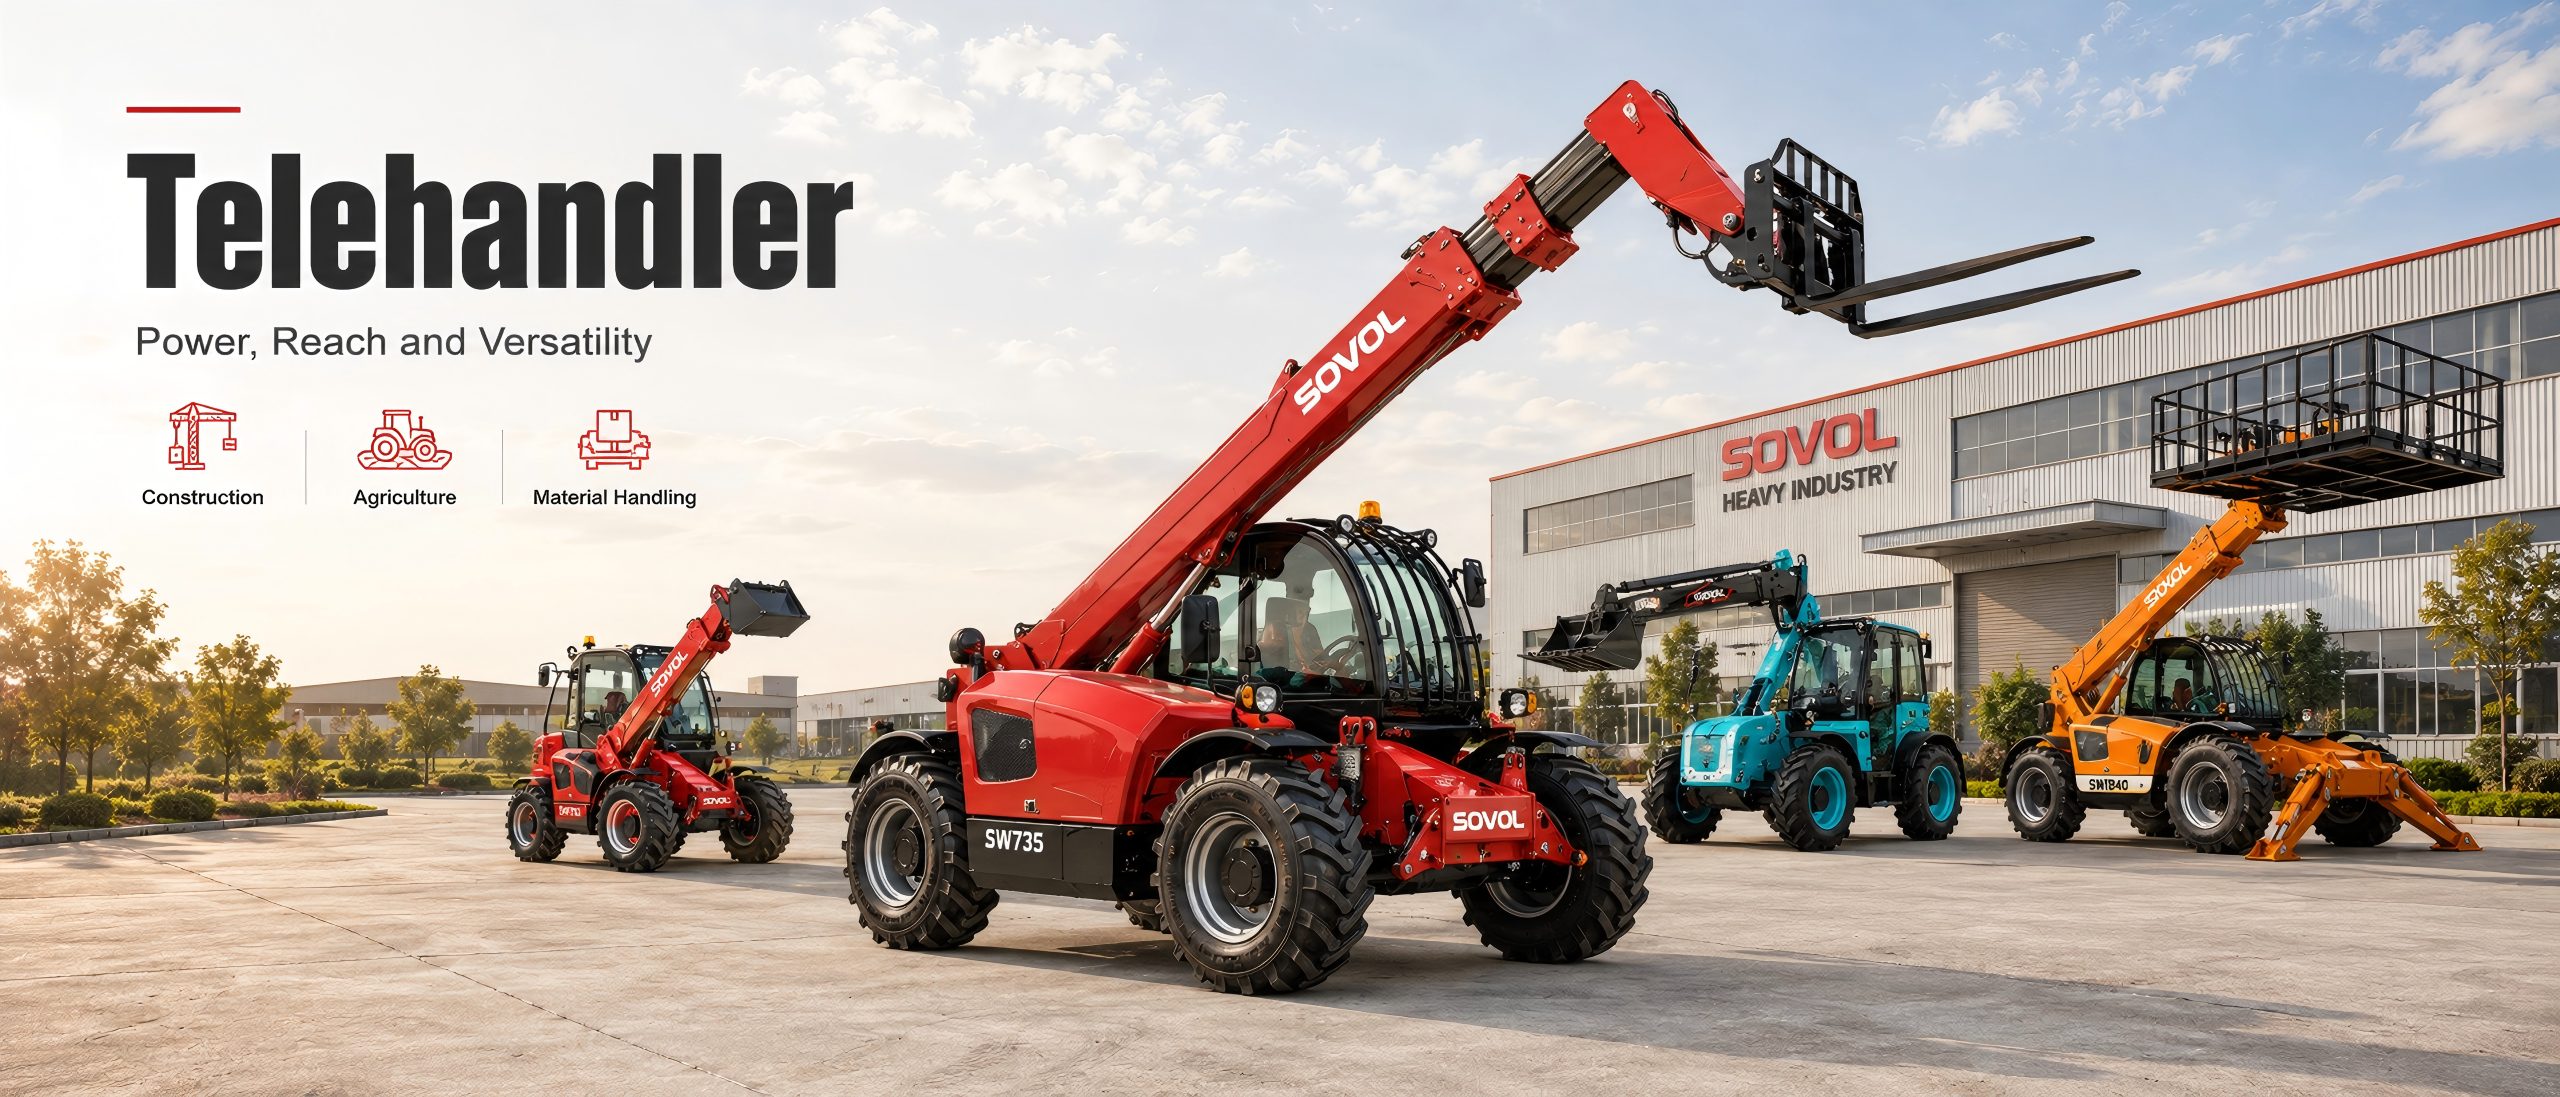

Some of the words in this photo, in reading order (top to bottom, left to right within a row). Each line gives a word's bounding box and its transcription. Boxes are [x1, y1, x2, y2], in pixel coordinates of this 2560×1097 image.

[1294, 310, 1407, 415] SOVOL
[1722, 408, 1897, 481] SOVOL
[1722, 482, 1787, 513] HEAVY
[1791, 461, 1898, 501] INDUSTRY
[650, 651, 689, 698] SOVOL
[984, 828, 1044, 853] SW735
[1452, 810, 1525, 832] SOVOL
